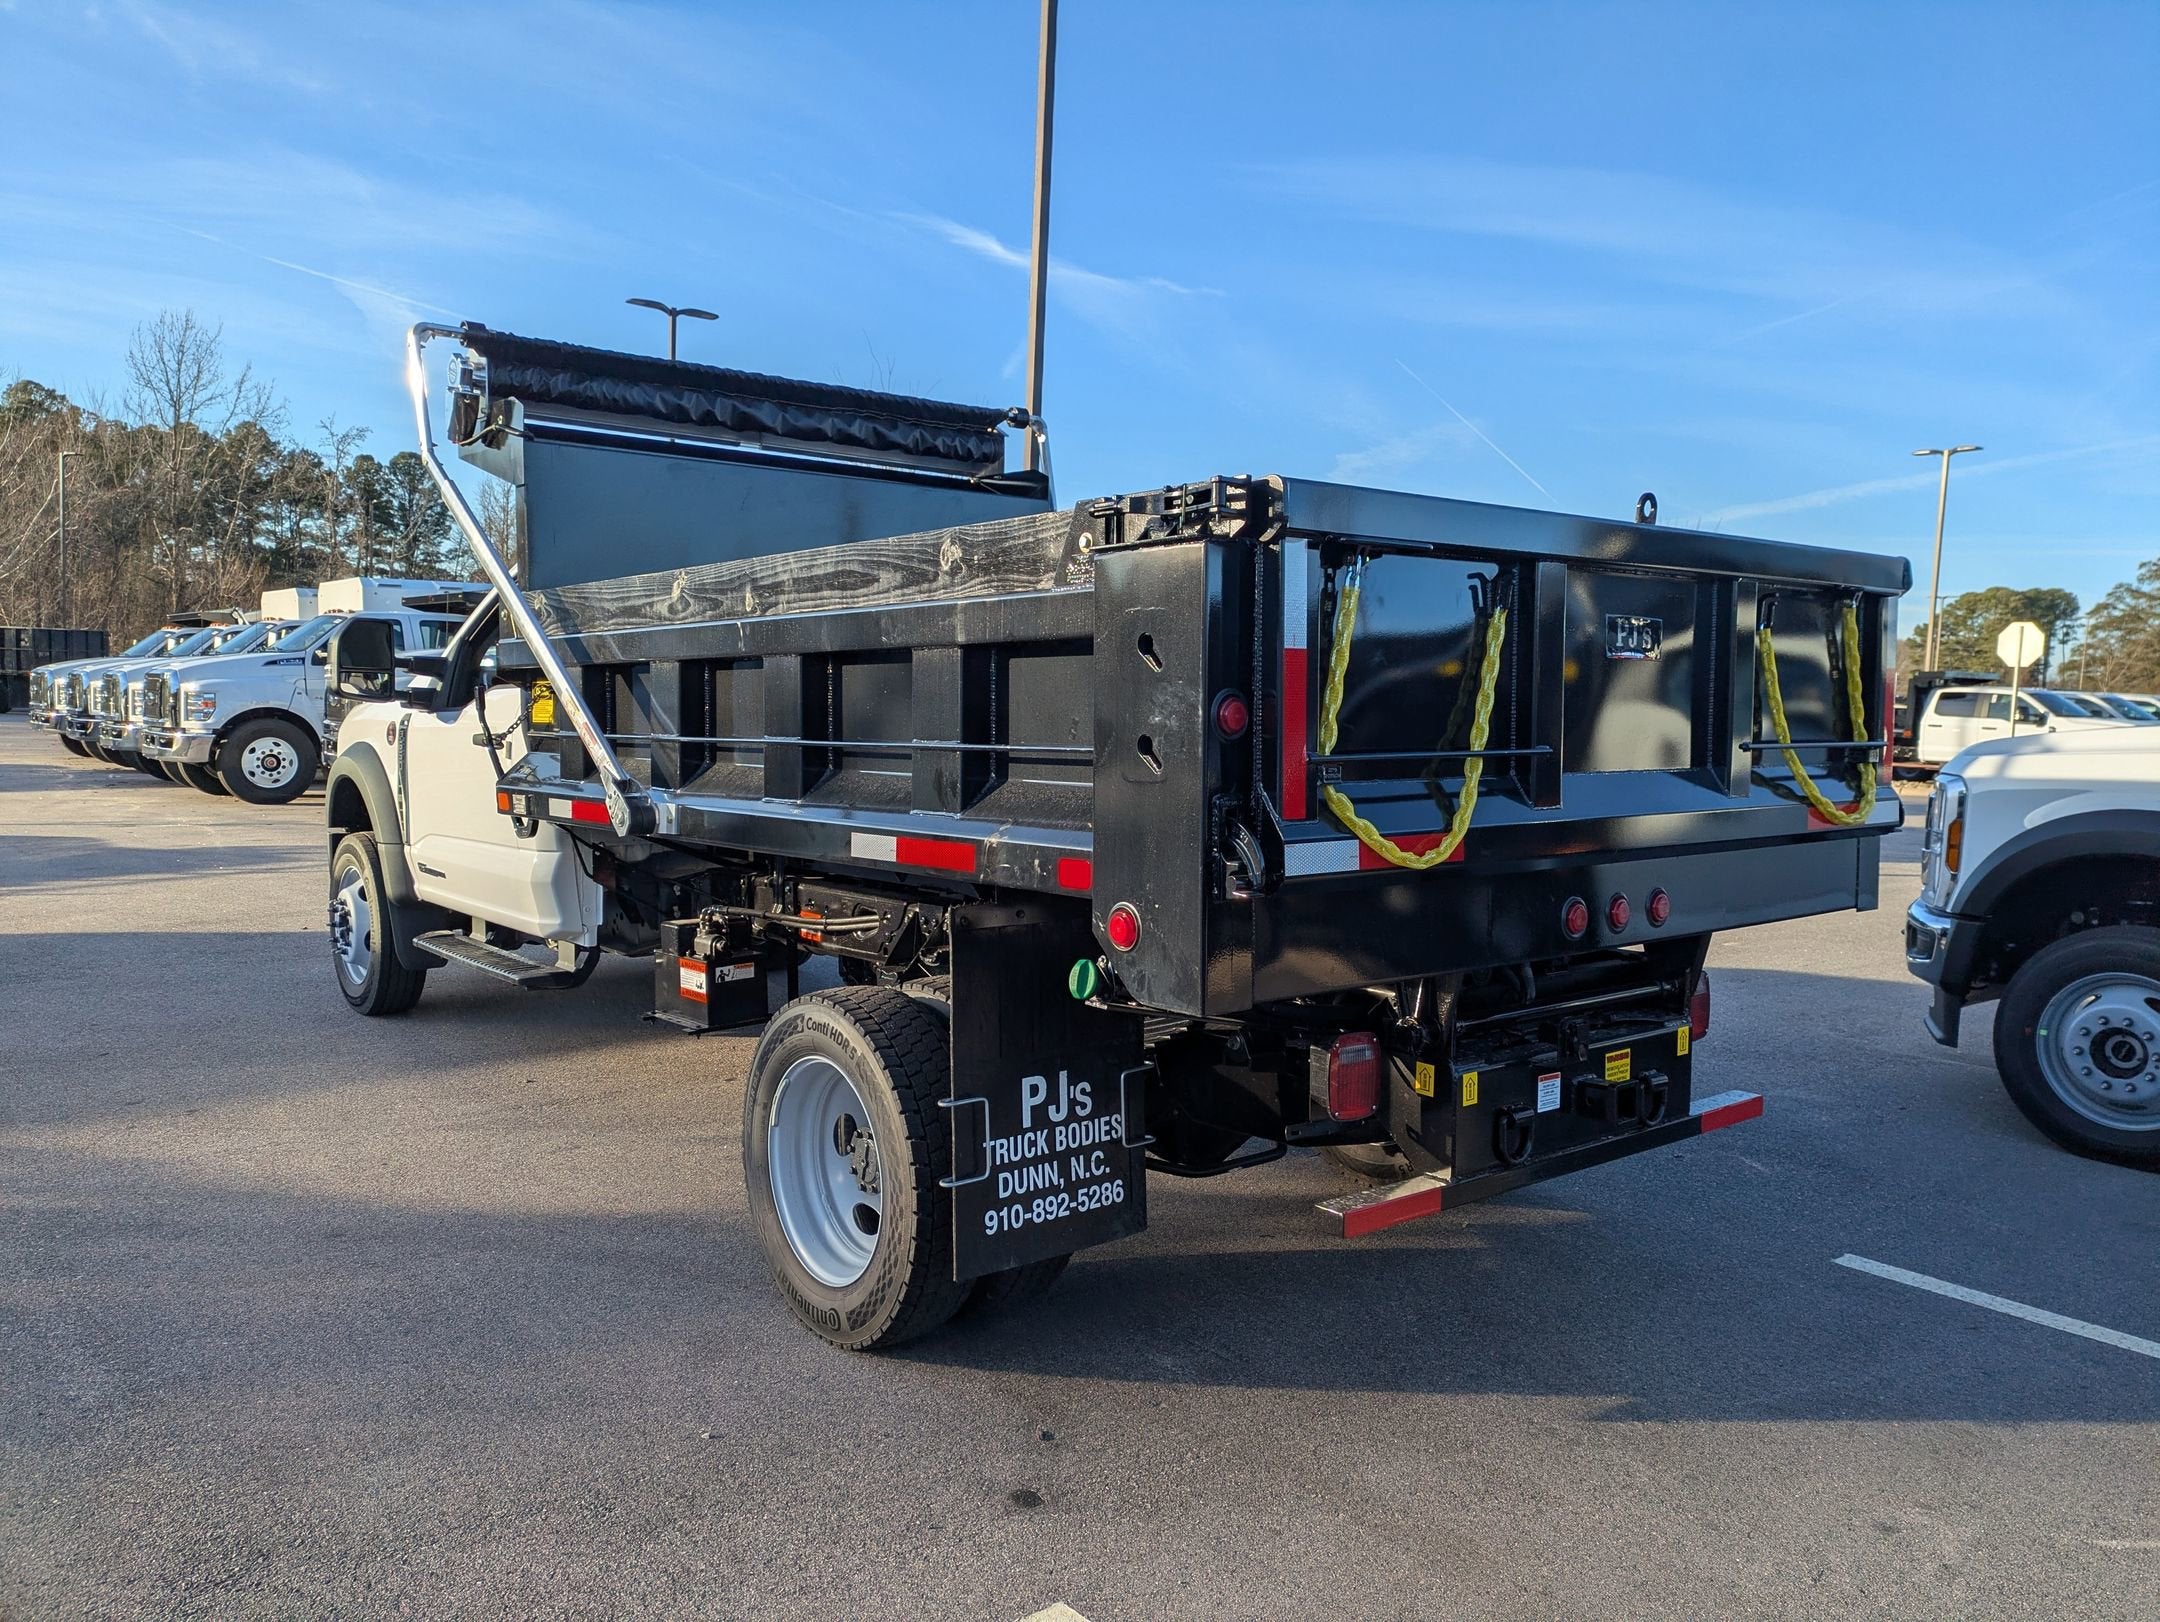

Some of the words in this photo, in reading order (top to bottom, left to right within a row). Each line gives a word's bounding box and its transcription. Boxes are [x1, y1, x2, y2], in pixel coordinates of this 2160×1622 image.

[806, 1016, 830, 1036] Conti
[830, 1025, 851, 1054] HDR
[983, 1129, 1049, 1167] TRUCK
[1055, 1113, 1122, 1152] BODIES
[998, 1160, 1065, 1199] DUNN,
[1070, 1150, 1110, 1182] N.C.
[984, 1179, 1125, 1236] 910-892-5286
[777, 1268, 841, 1332] Continental
